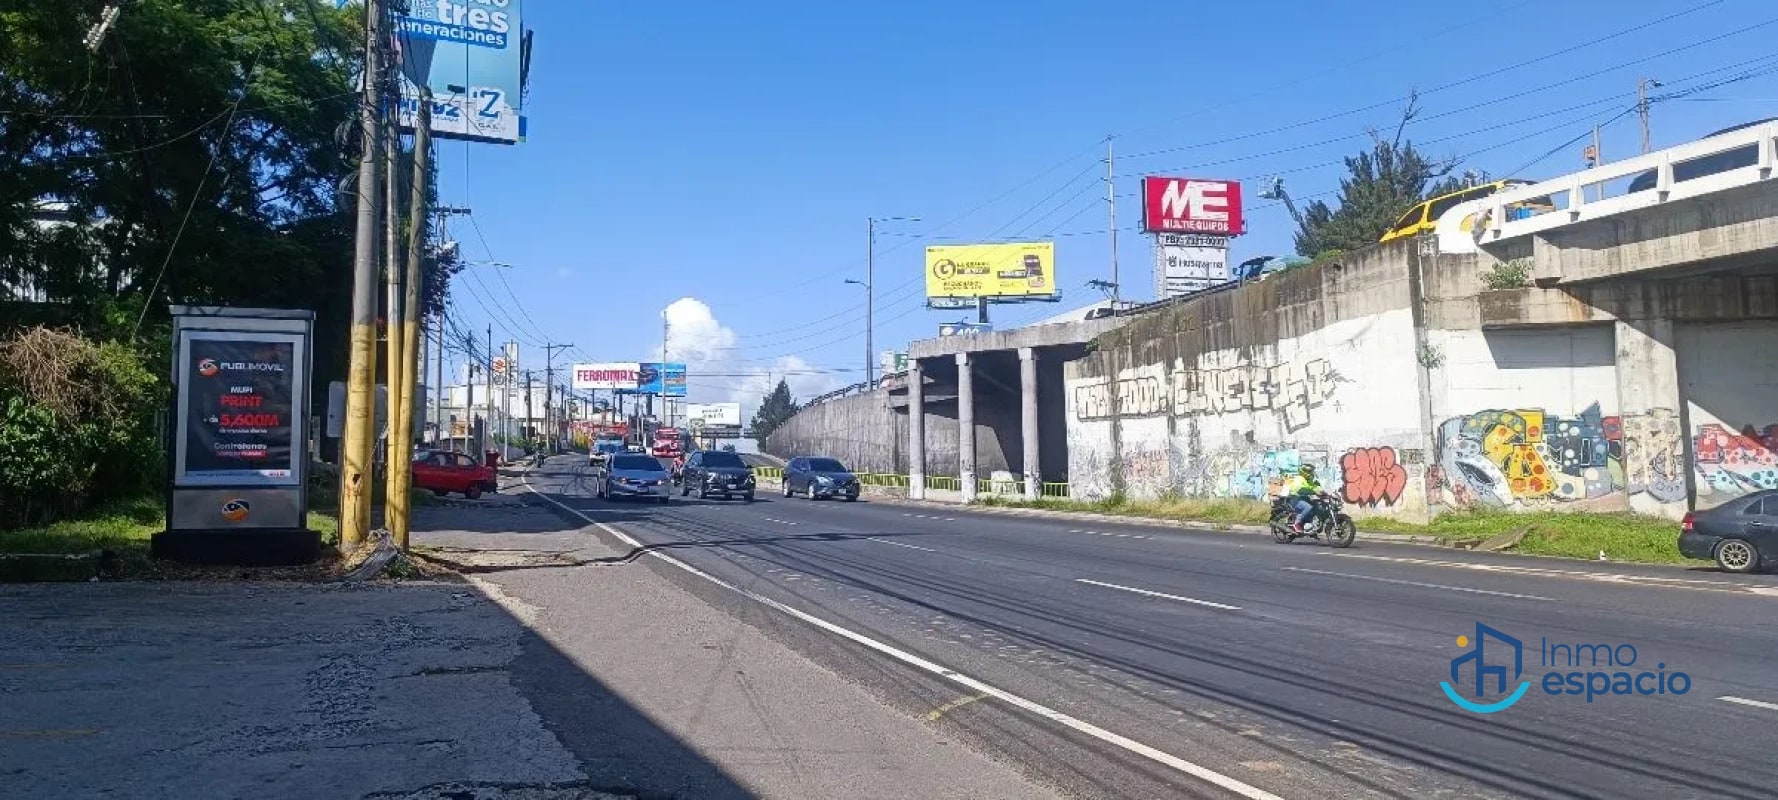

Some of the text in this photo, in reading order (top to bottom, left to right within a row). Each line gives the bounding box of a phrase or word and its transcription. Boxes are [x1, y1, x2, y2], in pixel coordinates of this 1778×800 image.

[437, 0, 508, 33] tres
[1161, 180, 1229, 221] ME
[230, 385, 253, 394] MUPI
[220, 395, 263, 407] PRINT
